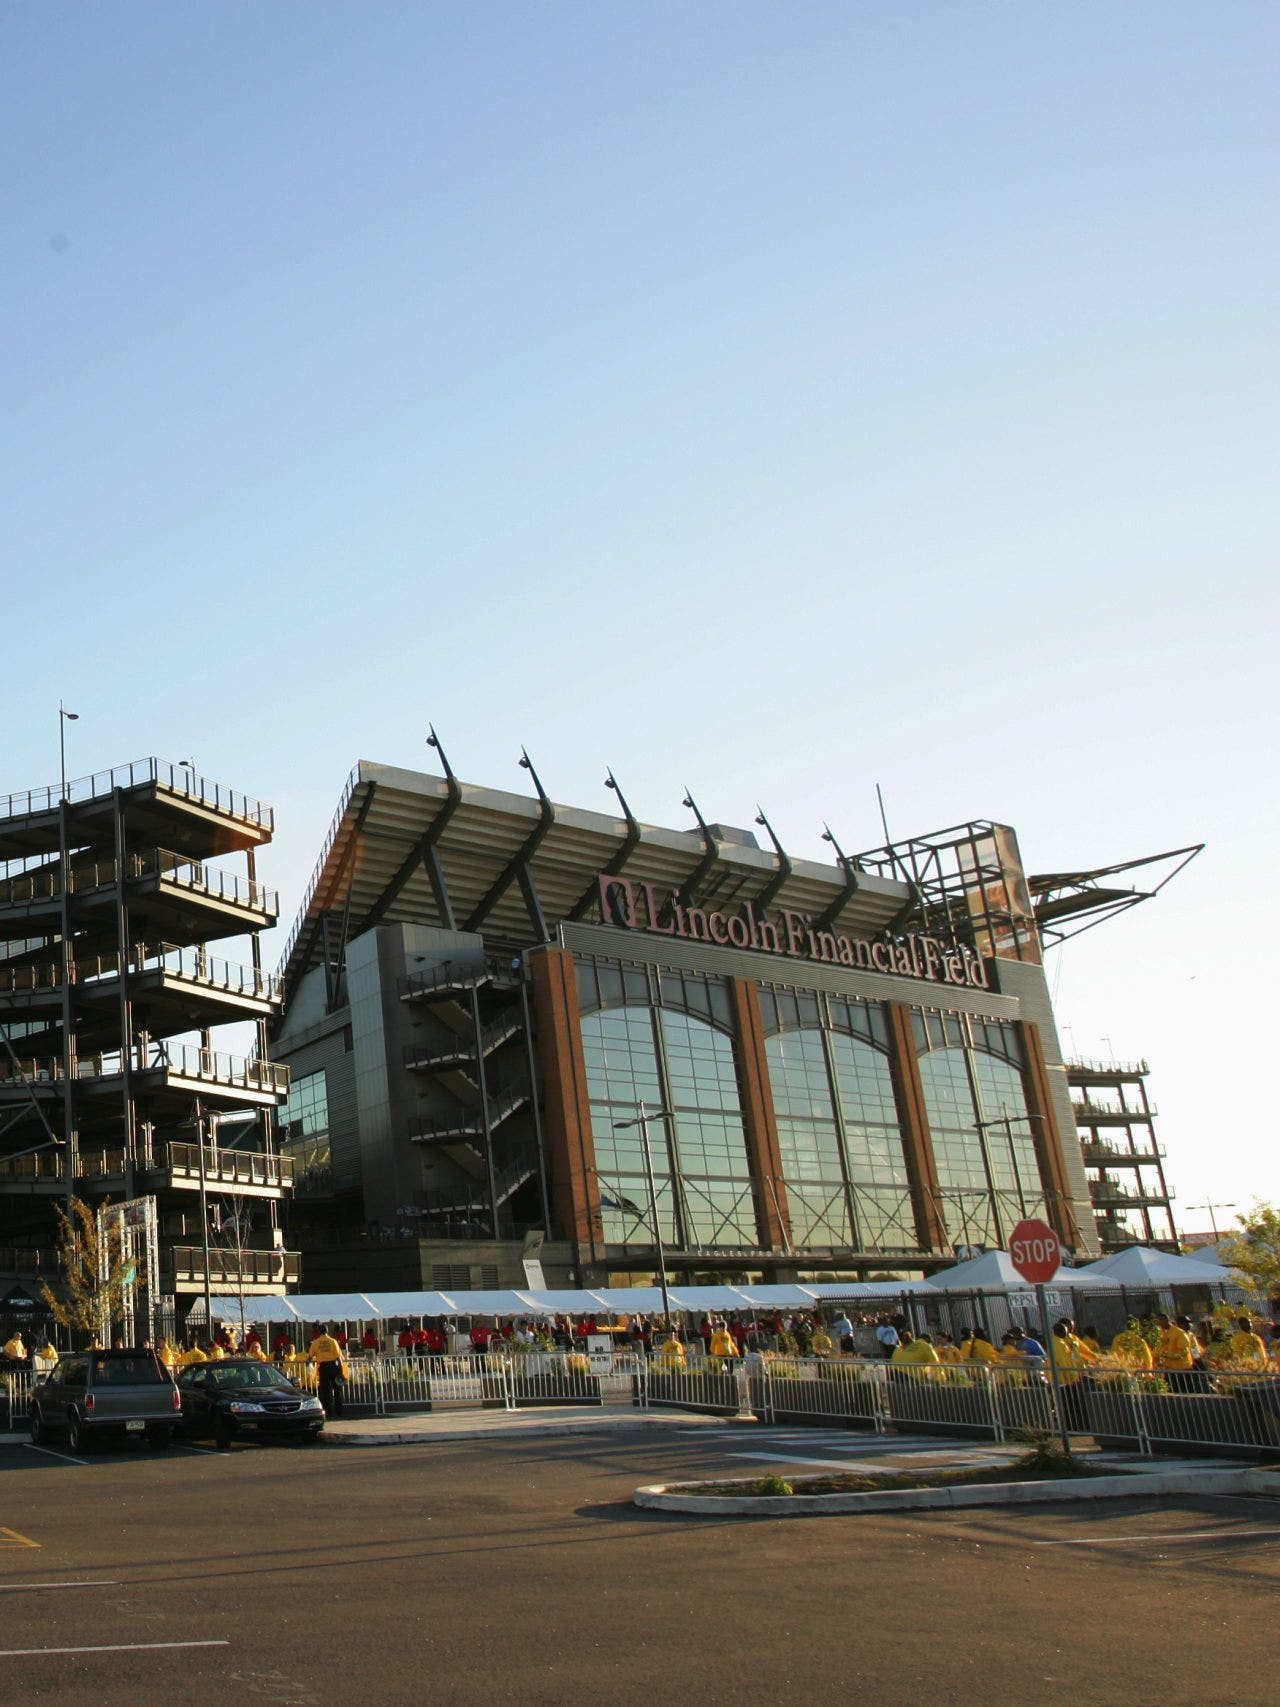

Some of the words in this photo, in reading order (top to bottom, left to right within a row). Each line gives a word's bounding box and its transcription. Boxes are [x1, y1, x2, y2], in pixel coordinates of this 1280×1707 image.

[640, 882, 783, 953] Lincoln
[780, 909, 923, 978] Financial
[918, 935, 989, 989] Field
[1013, 1239, 1055, 1263] STOP
